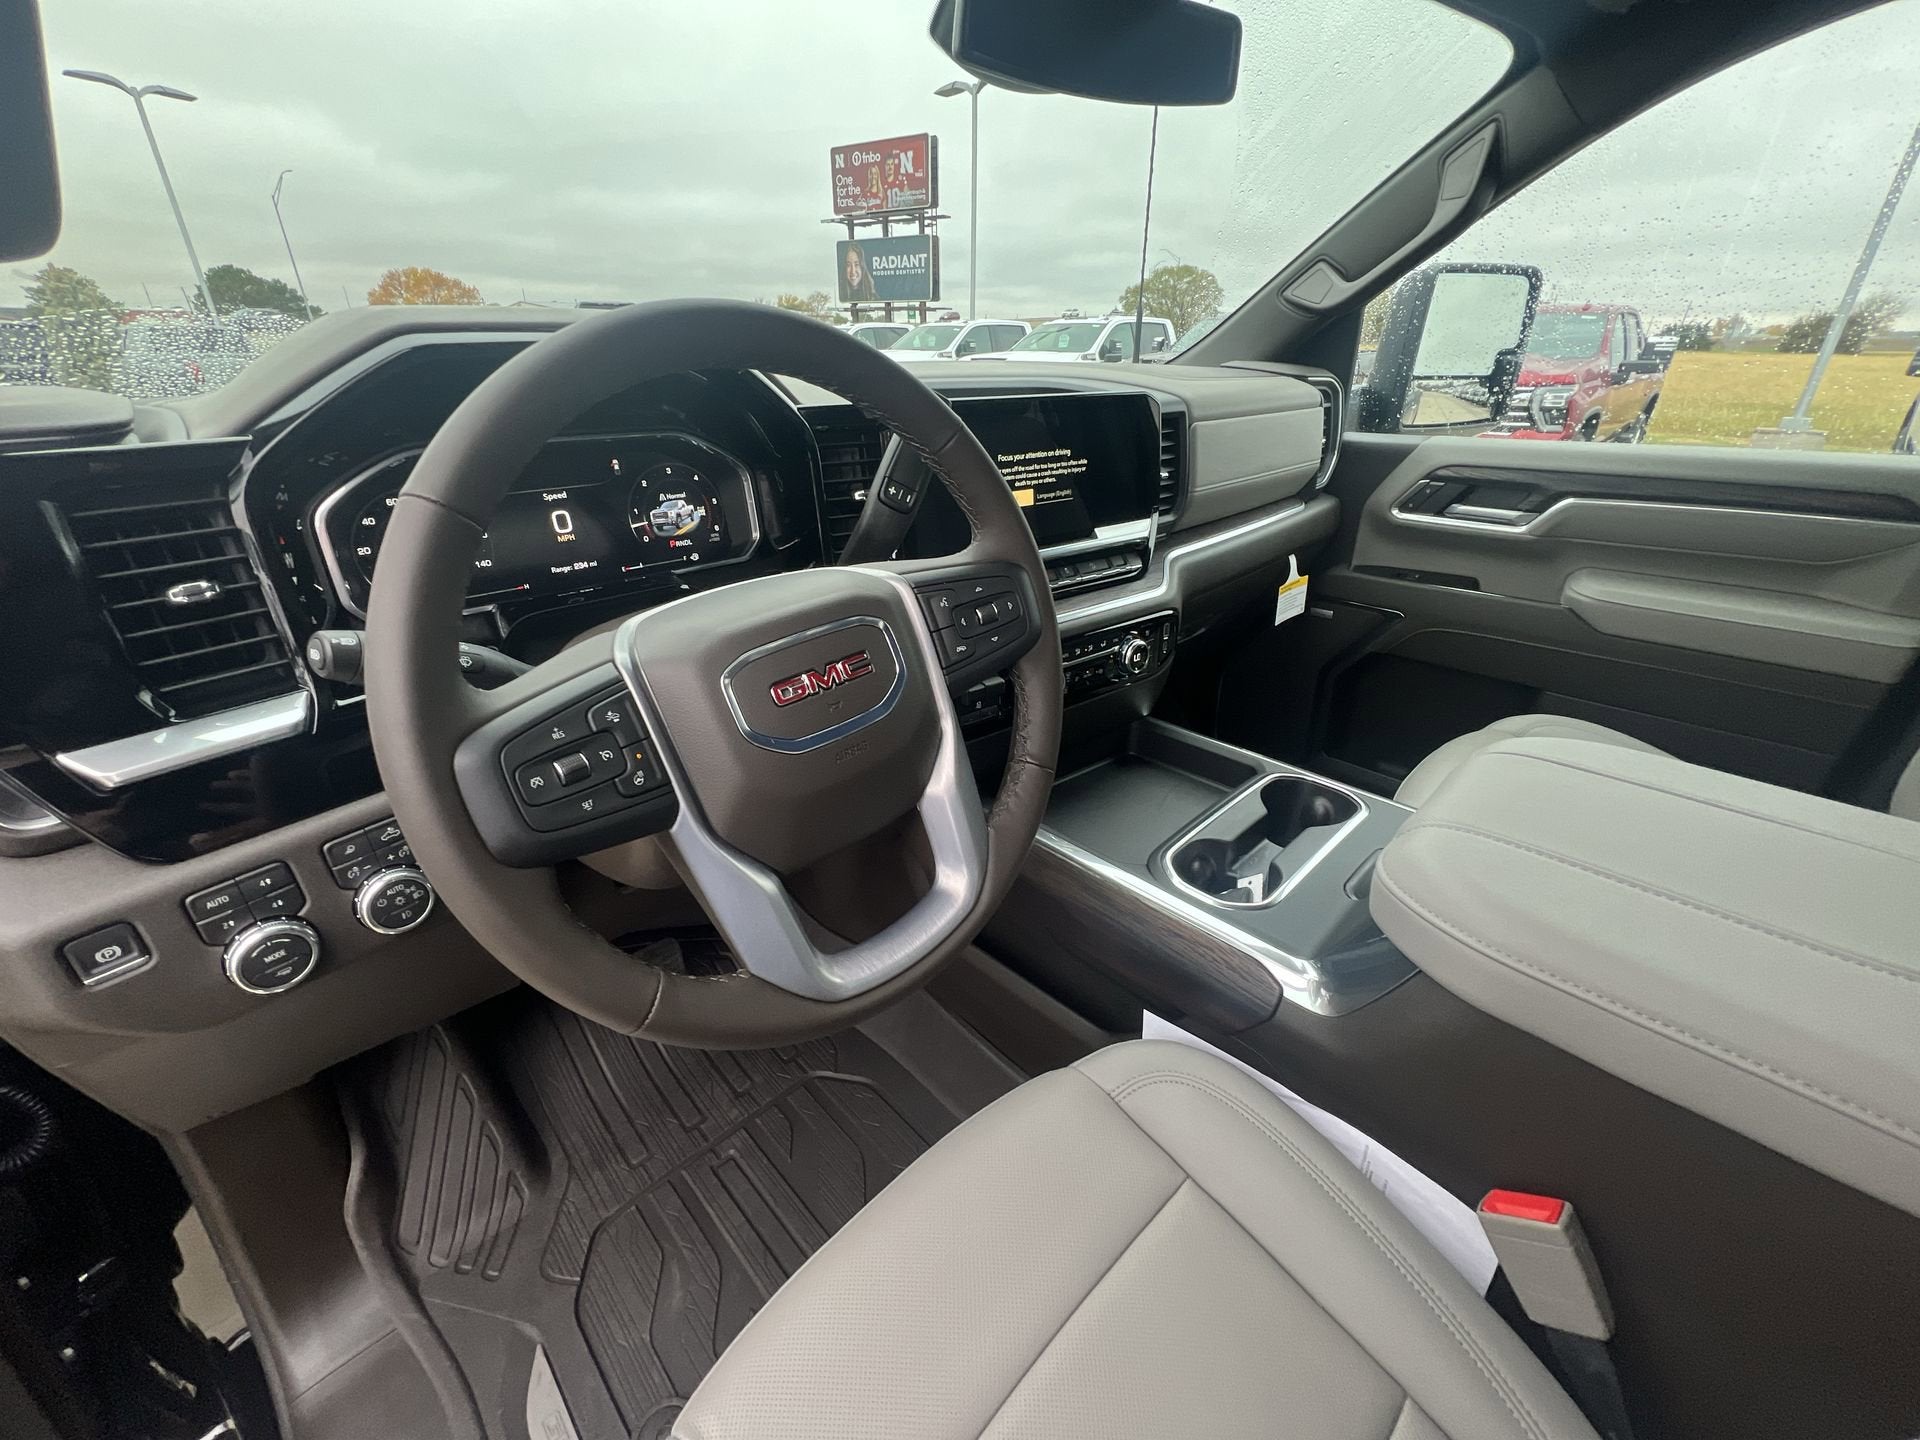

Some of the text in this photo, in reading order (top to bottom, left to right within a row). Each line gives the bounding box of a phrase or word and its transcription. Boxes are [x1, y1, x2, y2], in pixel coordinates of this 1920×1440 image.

[835, 153, 845, 169] N
[862, 151, 881, 164] fnbo
[836, 174, 853, 186] One
[837, 185, 861, 197] for the
[872, 253, 928, 269] RADIANT
[997, 454, 1013, 462] Focus
[1013, 454, 1025, 462] your
[1025, 450, 1048, 459] attention
[1055, 448, 1071, 457] driving
[1015, 472, 1027, 480] could
[542, 491, 568, 502] Speed
[666, 491, 687, 500] Normal
[1037, 492, 1056, 500] Language
[385, 498, 399, 506] 60
[361, 517, 376, 526] 40
[551, 510, 573, 534] 0
[557, 534, 576, 543] MPH
[357, 547, 372, 556] 20
[475, 559, 492, 568] 140
[551, 560, 598, 574] Range: 234 mi
[770, 650, 876, 707] GMC
[551, 730, 566, 740] RES
[581, 799, 593, 810] SET
[387, 884, 405, 897] AUTO
[206, 895, 230, 910] AUTO
[263, 949, 288, 965] MODE
